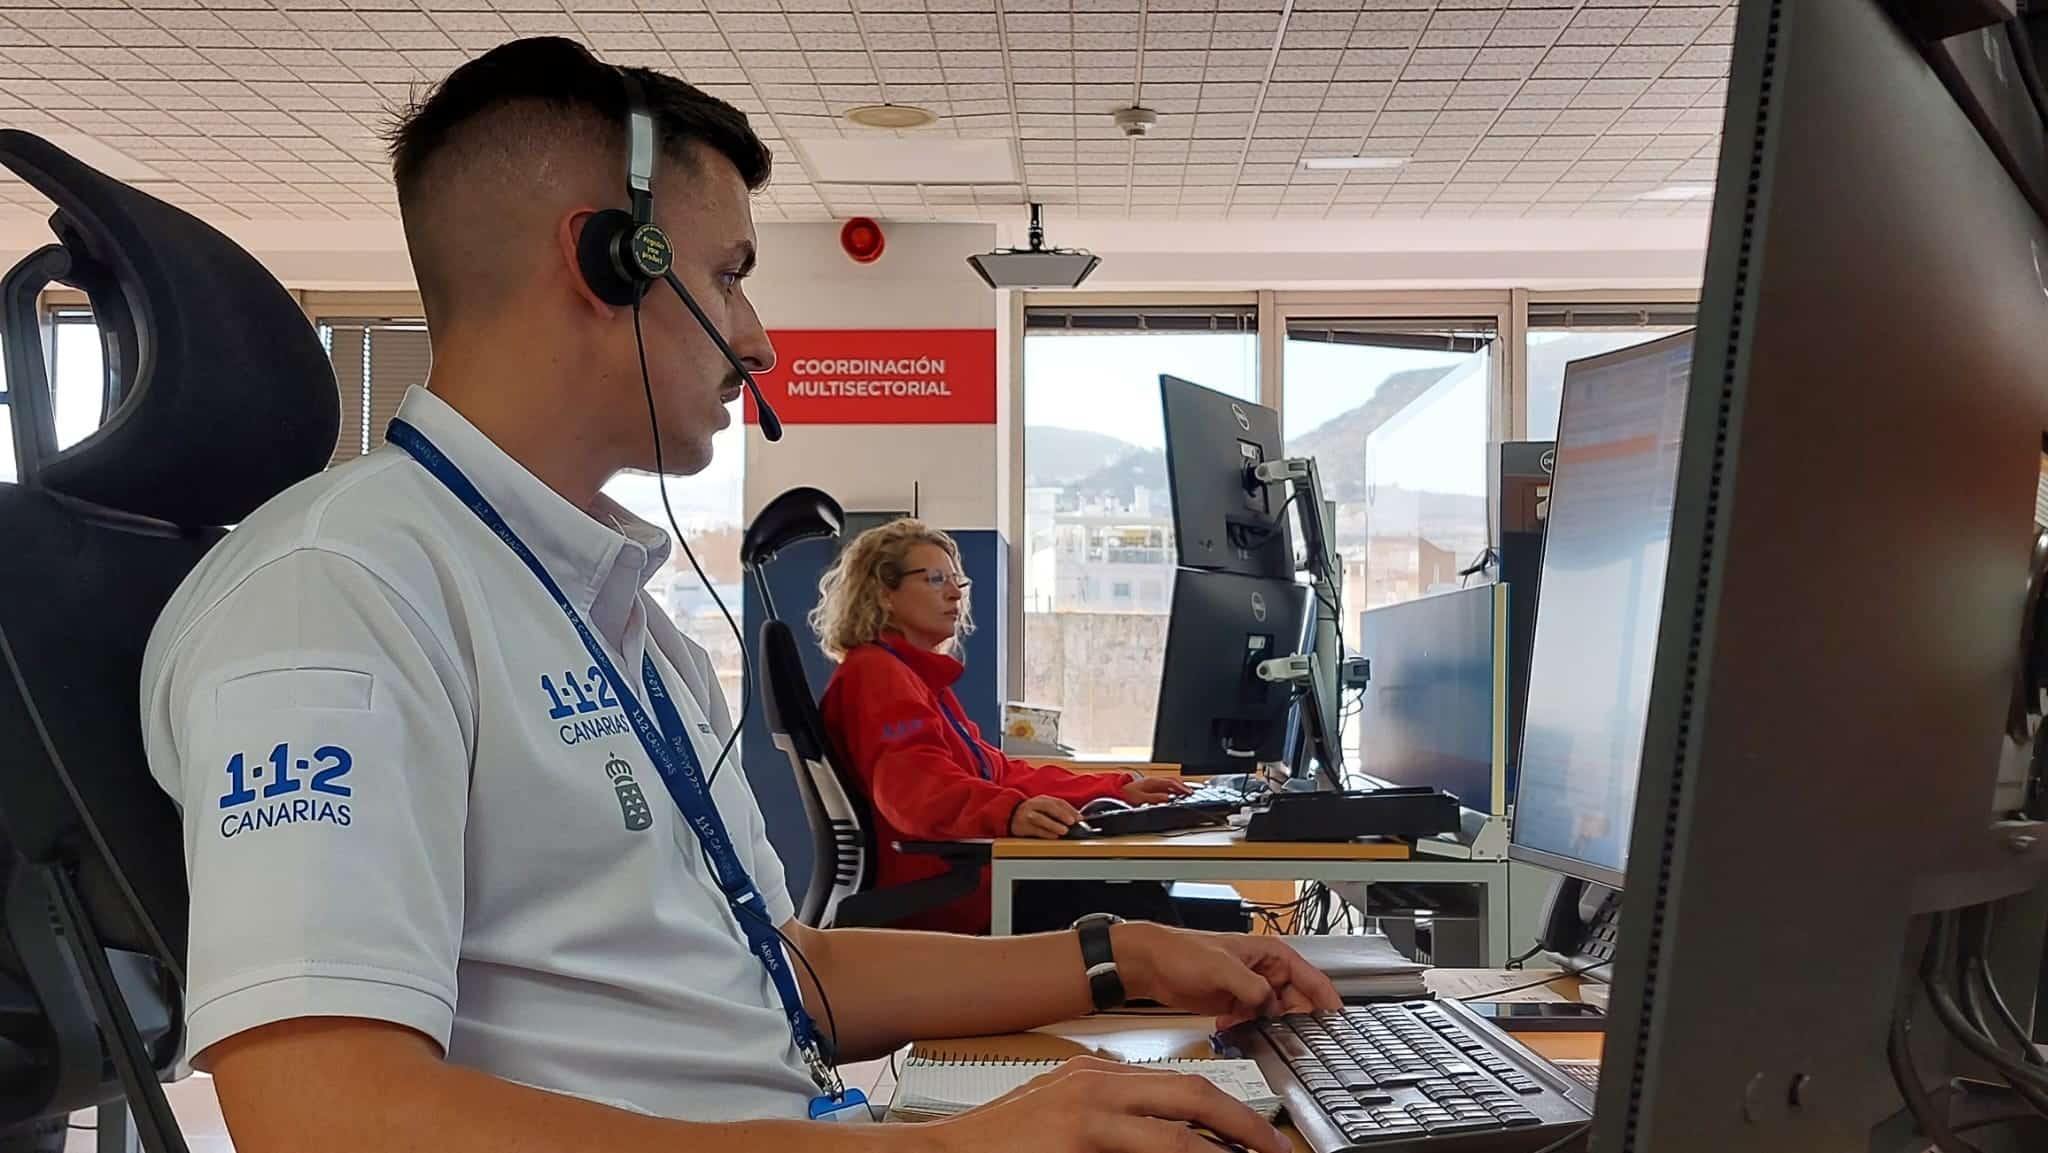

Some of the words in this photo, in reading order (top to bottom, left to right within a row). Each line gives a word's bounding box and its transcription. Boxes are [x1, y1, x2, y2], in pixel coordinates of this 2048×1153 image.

[792, 356, 945, 375] COORDINACIÓN
[787, 380, 952, 397] MULTISECTORIAL
[559, 713, 631, 745] CANARIAS
[220, 799, 351, 838] CANARIAS
